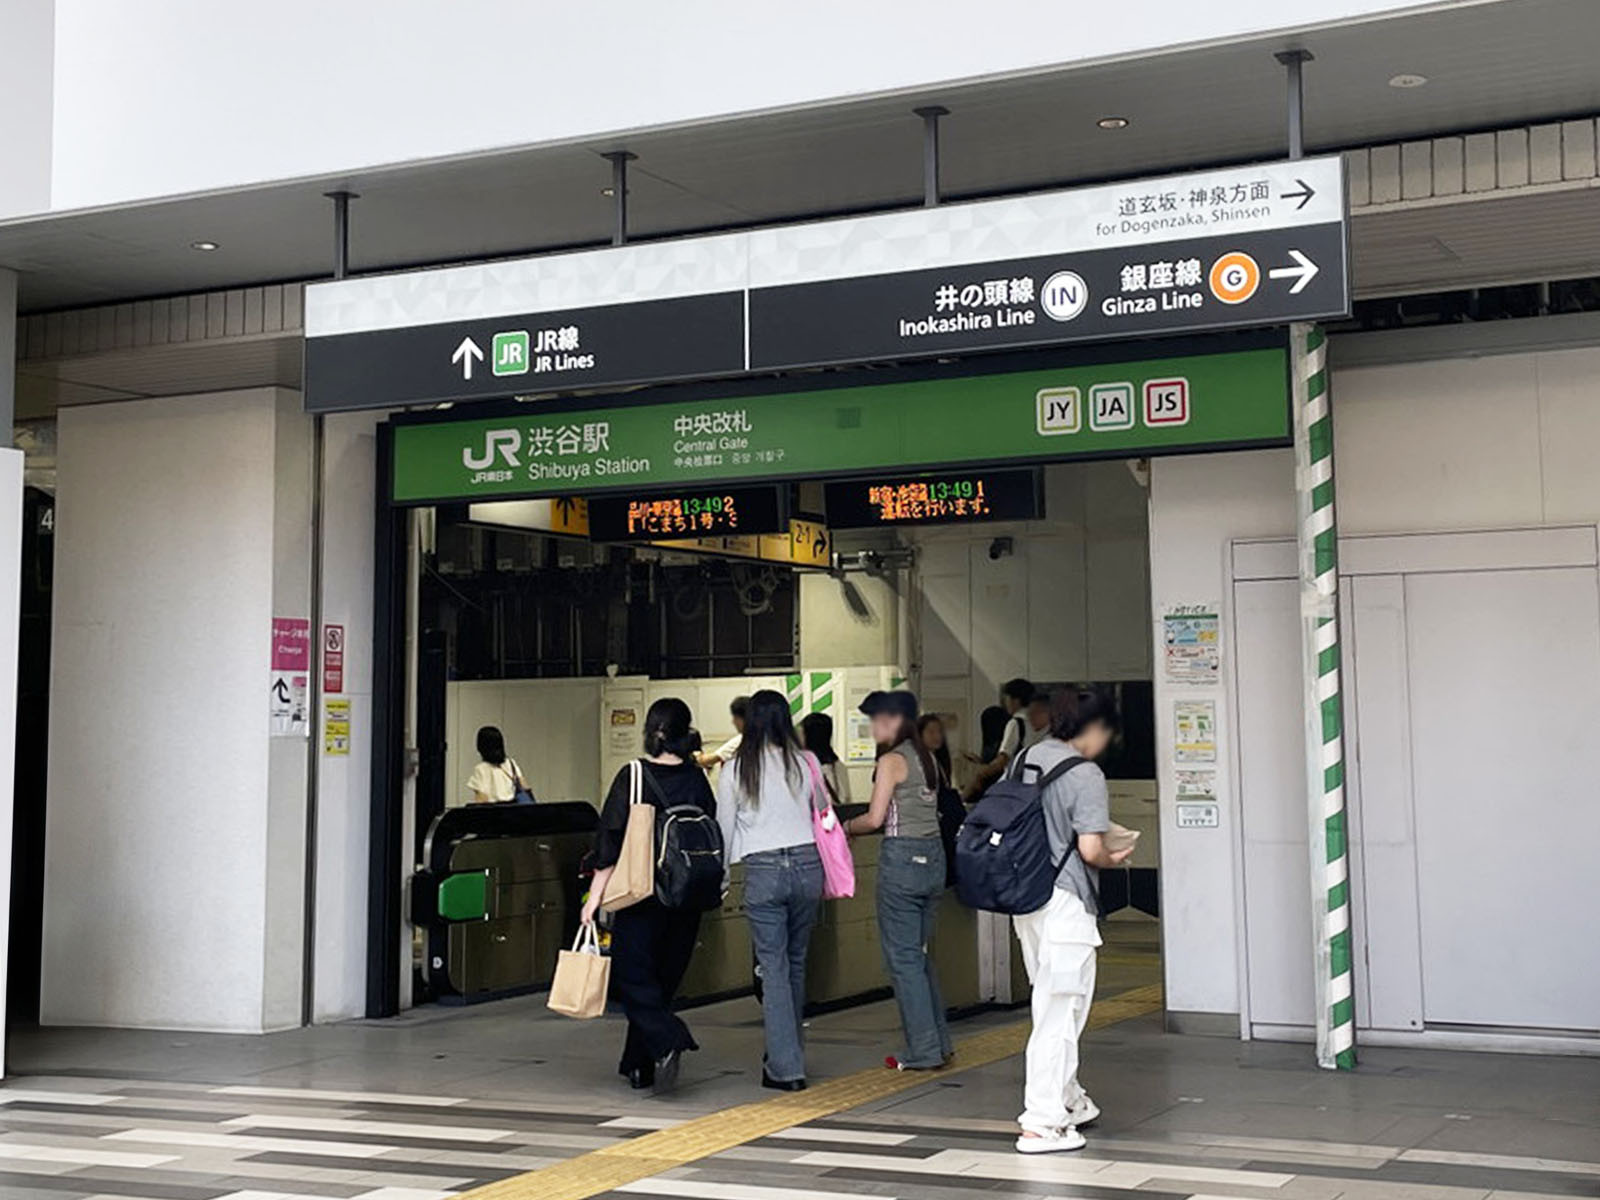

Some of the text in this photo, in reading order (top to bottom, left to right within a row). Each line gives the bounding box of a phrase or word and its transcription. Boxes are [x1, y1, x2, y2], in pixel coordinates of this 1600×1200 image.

[1096, 205, 1271, 236] for Dogenzaka, Shinsen
[1120, 258, 1203, 292] 銀座線
[1226, 270, 1243, 287] G
[935, 276, 1036, 312] 井の頭線
[1051, 286, 1077, 306] IN
[1101, 290, 1204, 317] Ginza Line
[899, 308, 1036, 337] Inokashira Line
[534, 325, 579, 353] JR線
[498, 342, 523, 365] JR
[534, 353, 596, 373] JR Lines
[1047, 401, 1070, 421] JY
[1099, 397, 1125, 417] JA
[1155, 392, 1177, 412] JS
[674, 410, 753, 437] 中央改札
[463, 428, 522, 470] JR
[528, 422, 610, 457] 渋谷駅
[673, 436, 748, 454] Central Gate
[528, 456, 650, 481] Shibuya Station
